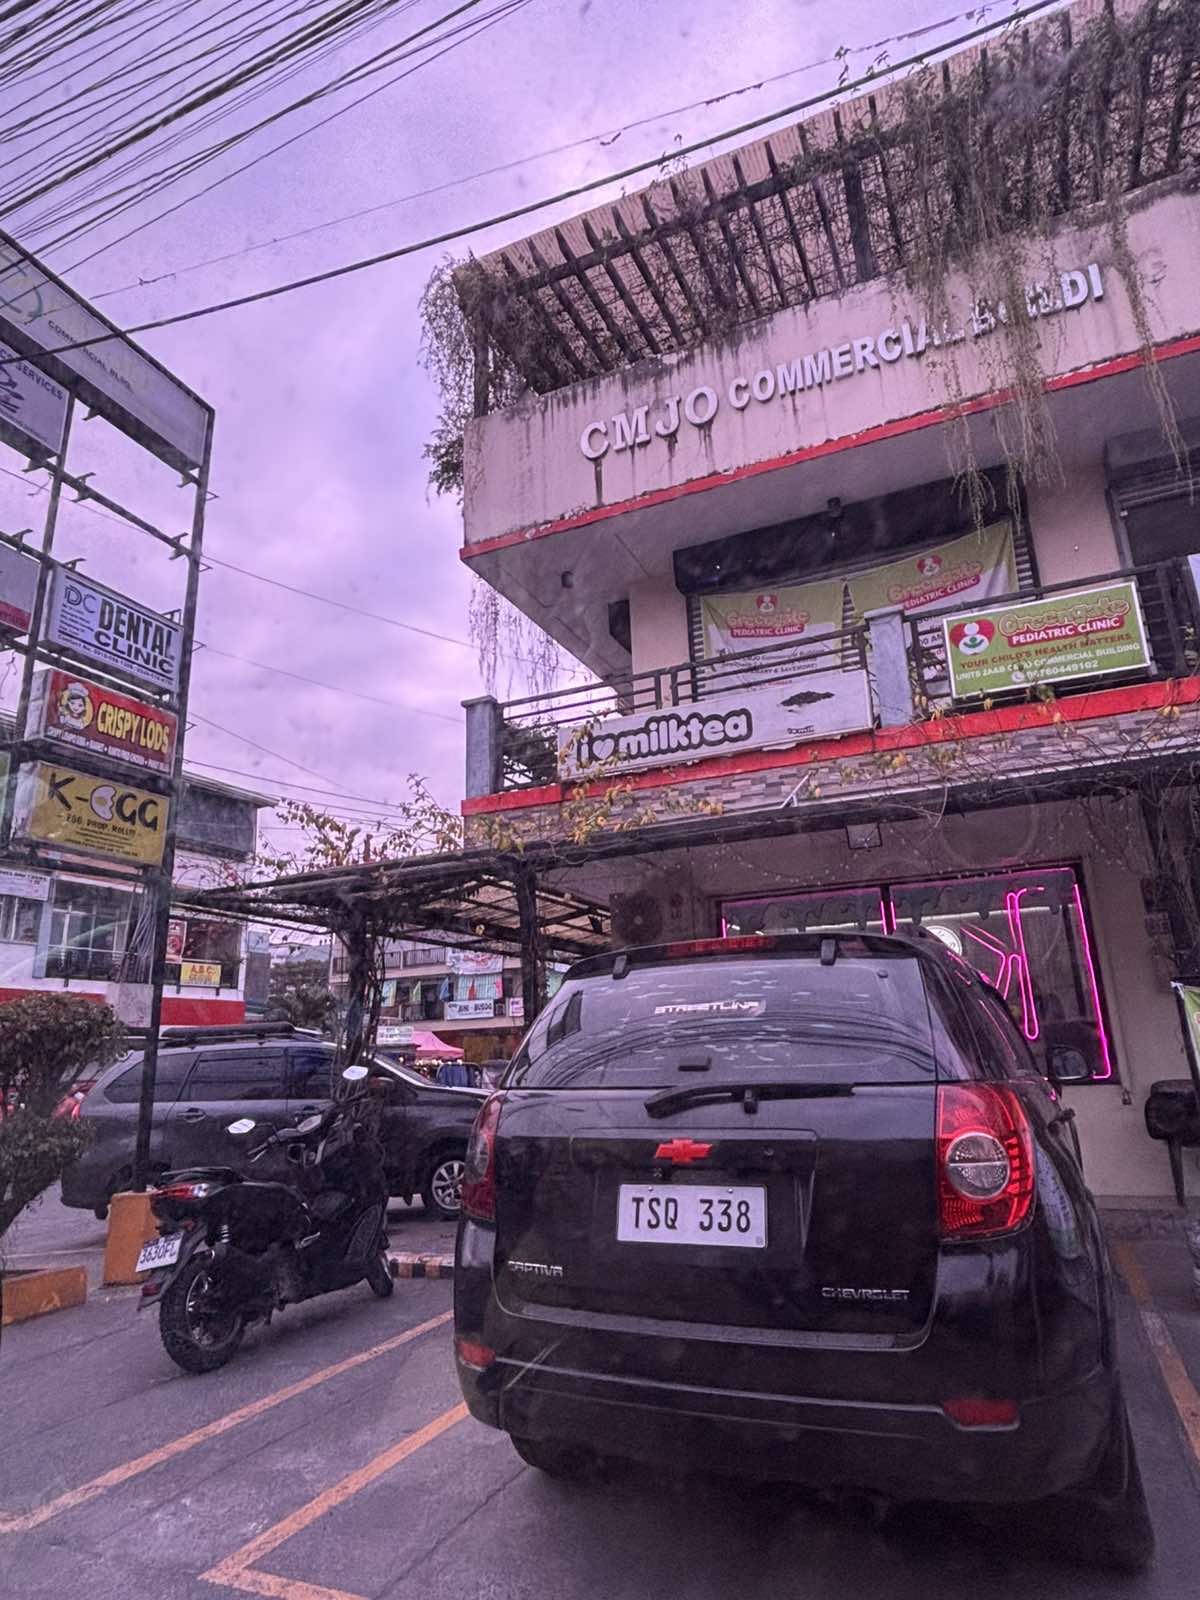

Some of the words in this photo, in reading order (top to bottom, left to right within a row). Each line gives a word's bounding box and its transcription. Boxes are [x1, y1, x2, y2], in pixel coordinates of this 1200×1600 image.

[98, 598, 175, 661] DENTAL
[1012, 626, 1075, 645] PEDIATRIC
[1077, 617, 1120, 634] CLINIC
[94, 629, 175, 674] CLINIC
[959, 658, 989, 670] YOUR
[1034, 642, 1079, 657] HEALTH
[1095, 642, 1141, 657] BUILDING
[96, 701, 140, 743] CRISPY
[140, 718, 170, 754] LODS
[617, 710, 751, 758] milktea
[631, 1196, 679, 1230] TSQ
[699, 1199, 752, 1233] 338
[507, 1259, 564, 1279] CAPTIVA
[821, 1286, 910, 1302] CHEVROLET
